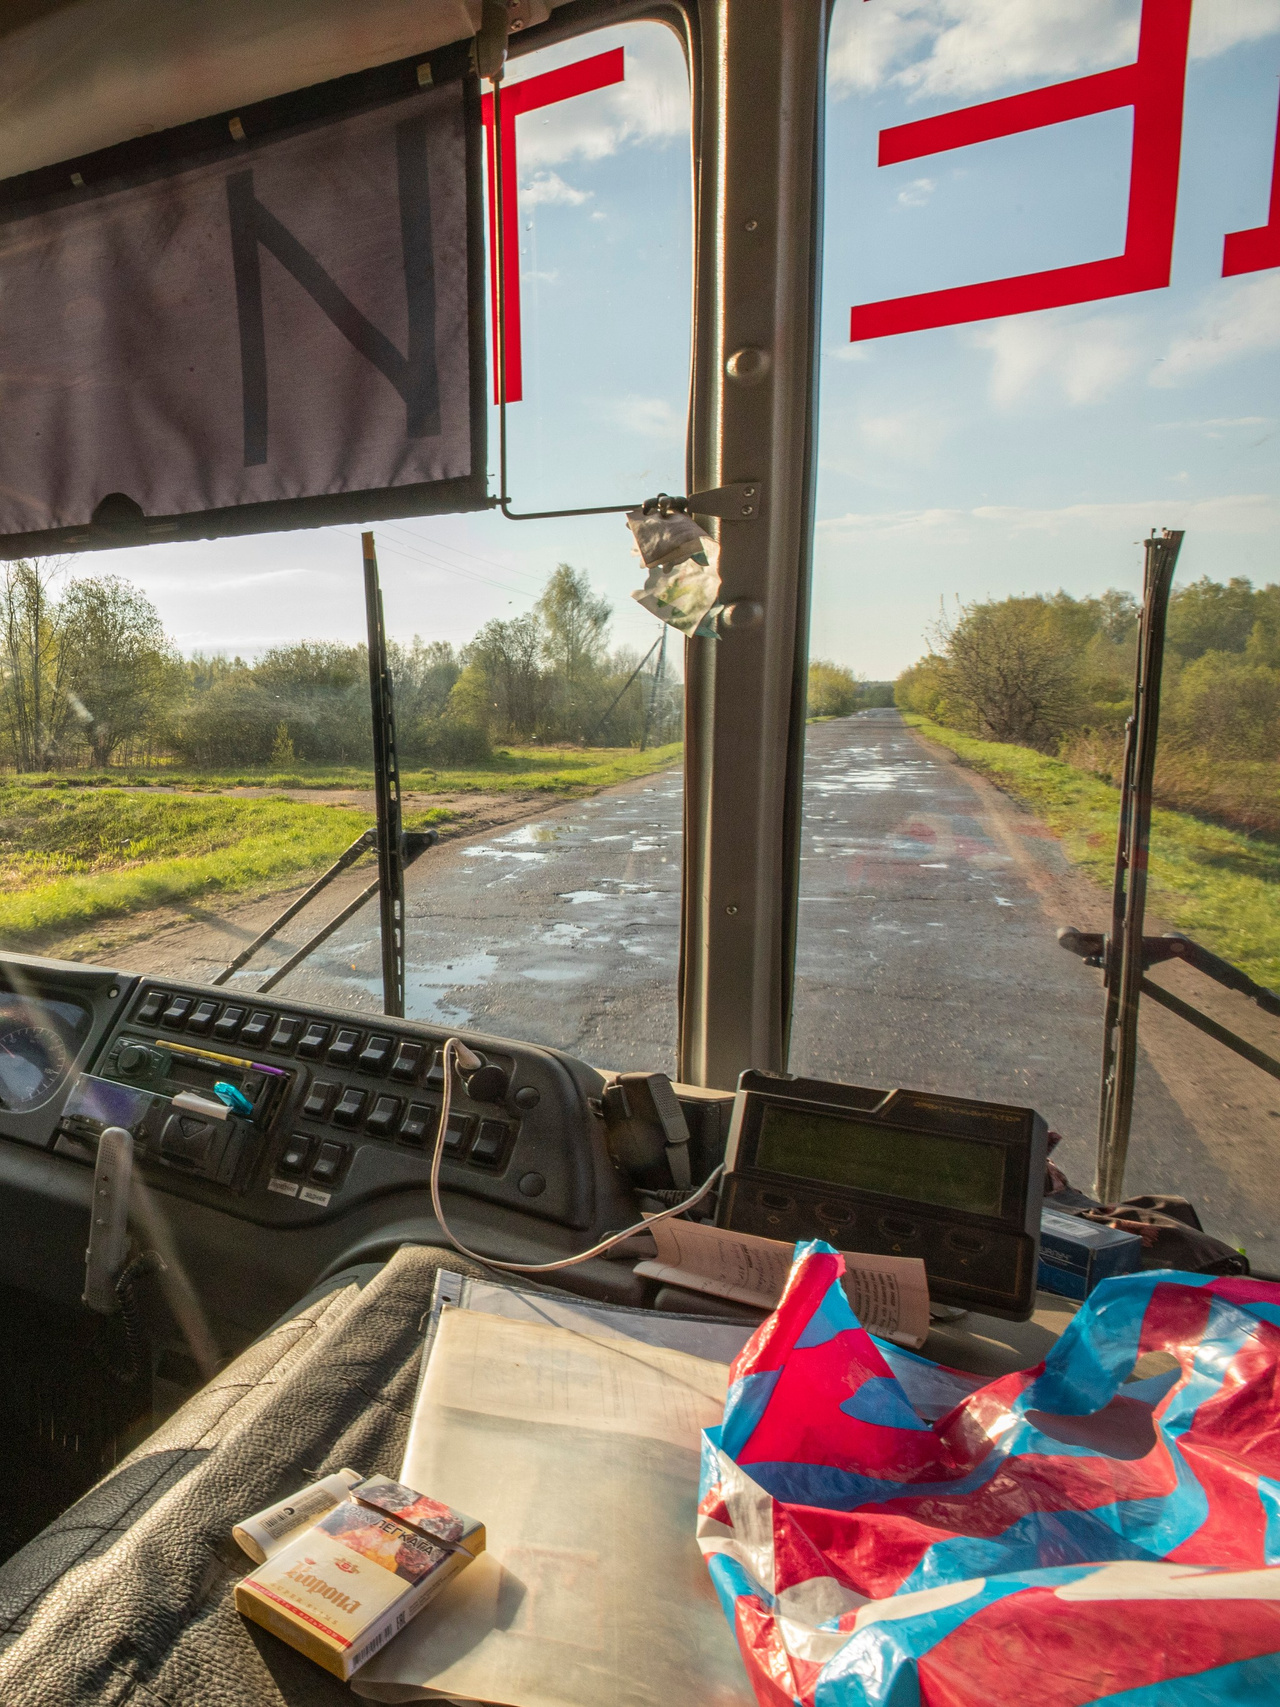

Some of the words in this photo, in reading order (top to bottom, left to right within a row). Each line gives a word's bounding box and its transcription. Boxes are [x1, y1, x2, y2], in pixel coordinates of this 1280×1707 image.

[347, 1505, 371, 1523] РАК
[372, 1516, 435, 1557] ЛЁГКАГА
[270, 1582, 303, 1604] SUPER
[282, 1560, 362, 1615] Корона
